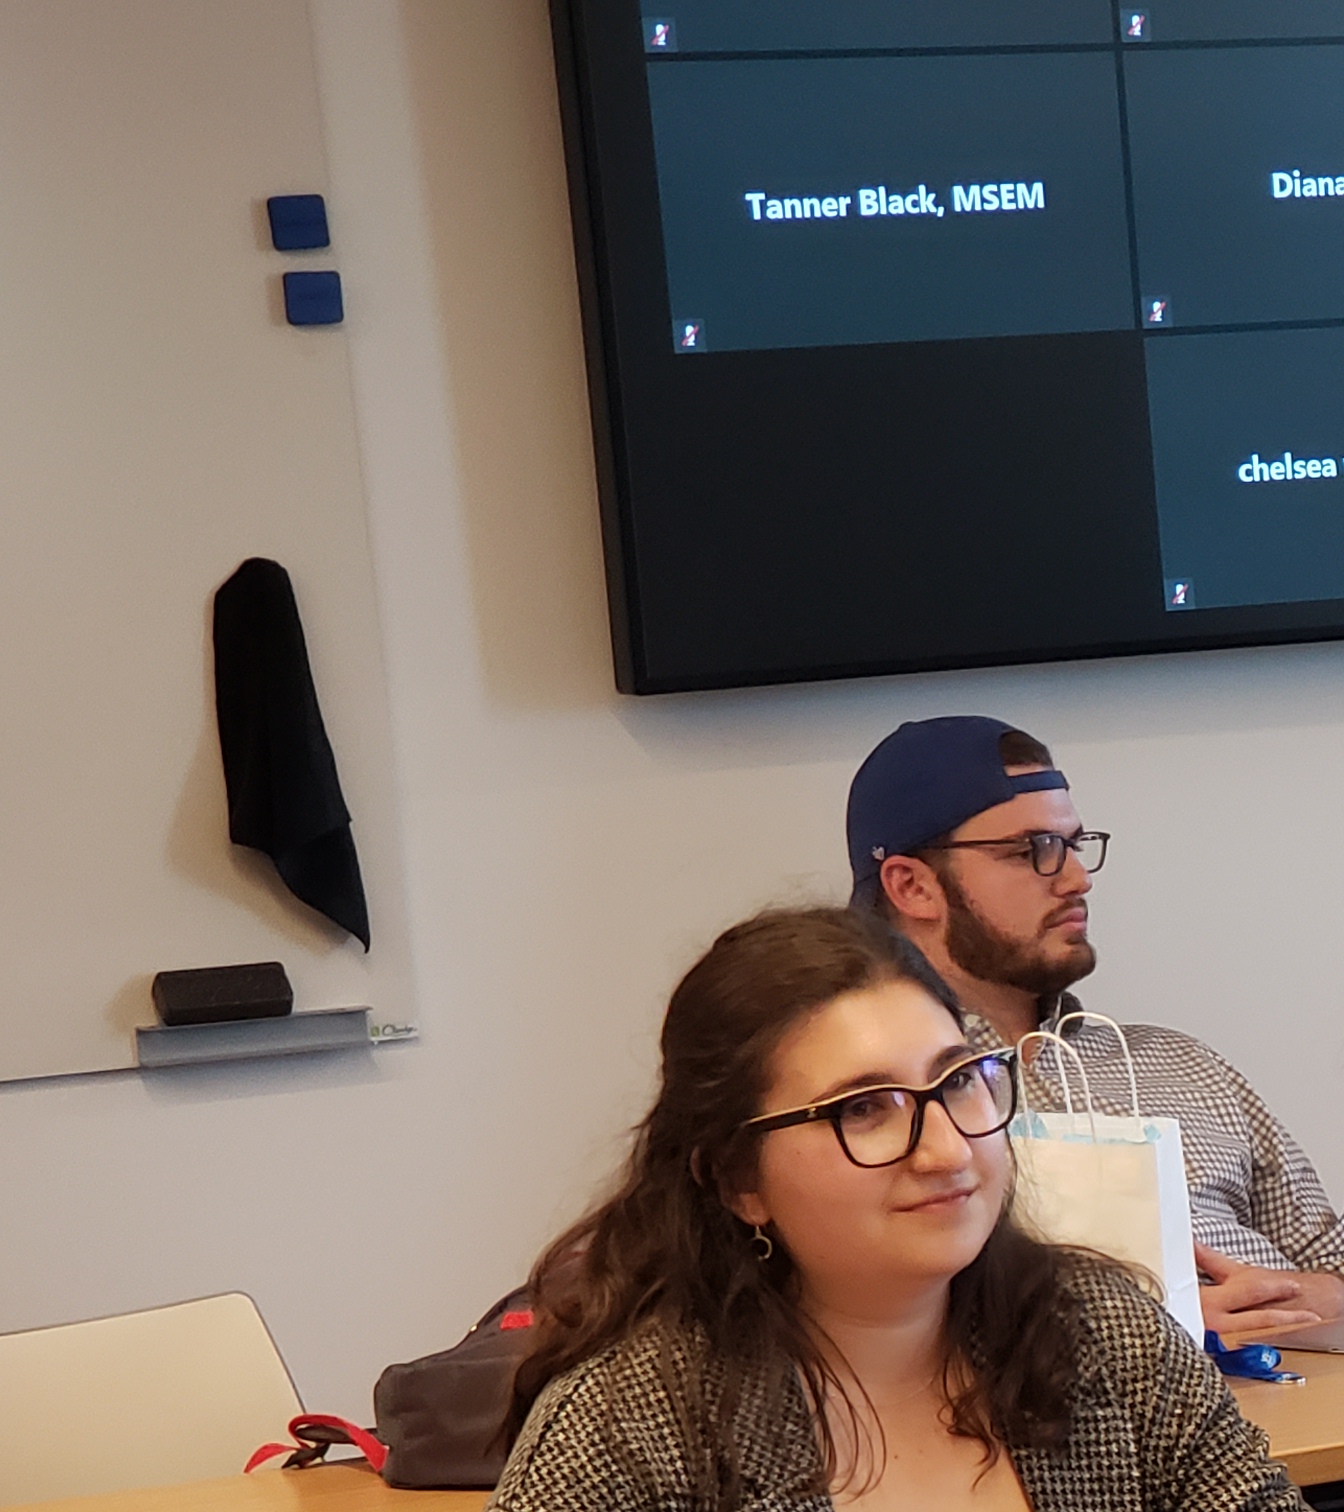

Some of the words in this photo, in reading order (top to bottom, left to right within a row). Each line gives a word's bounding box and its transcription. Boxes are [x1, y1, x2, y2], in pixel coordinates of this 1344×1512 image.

[745, 193, 851, 220] Tanner
[858, 186, 945, 217] Black,
[952, 182, 1046, 211] MSEM
[1237, 451, 1338, 482] chelsea
